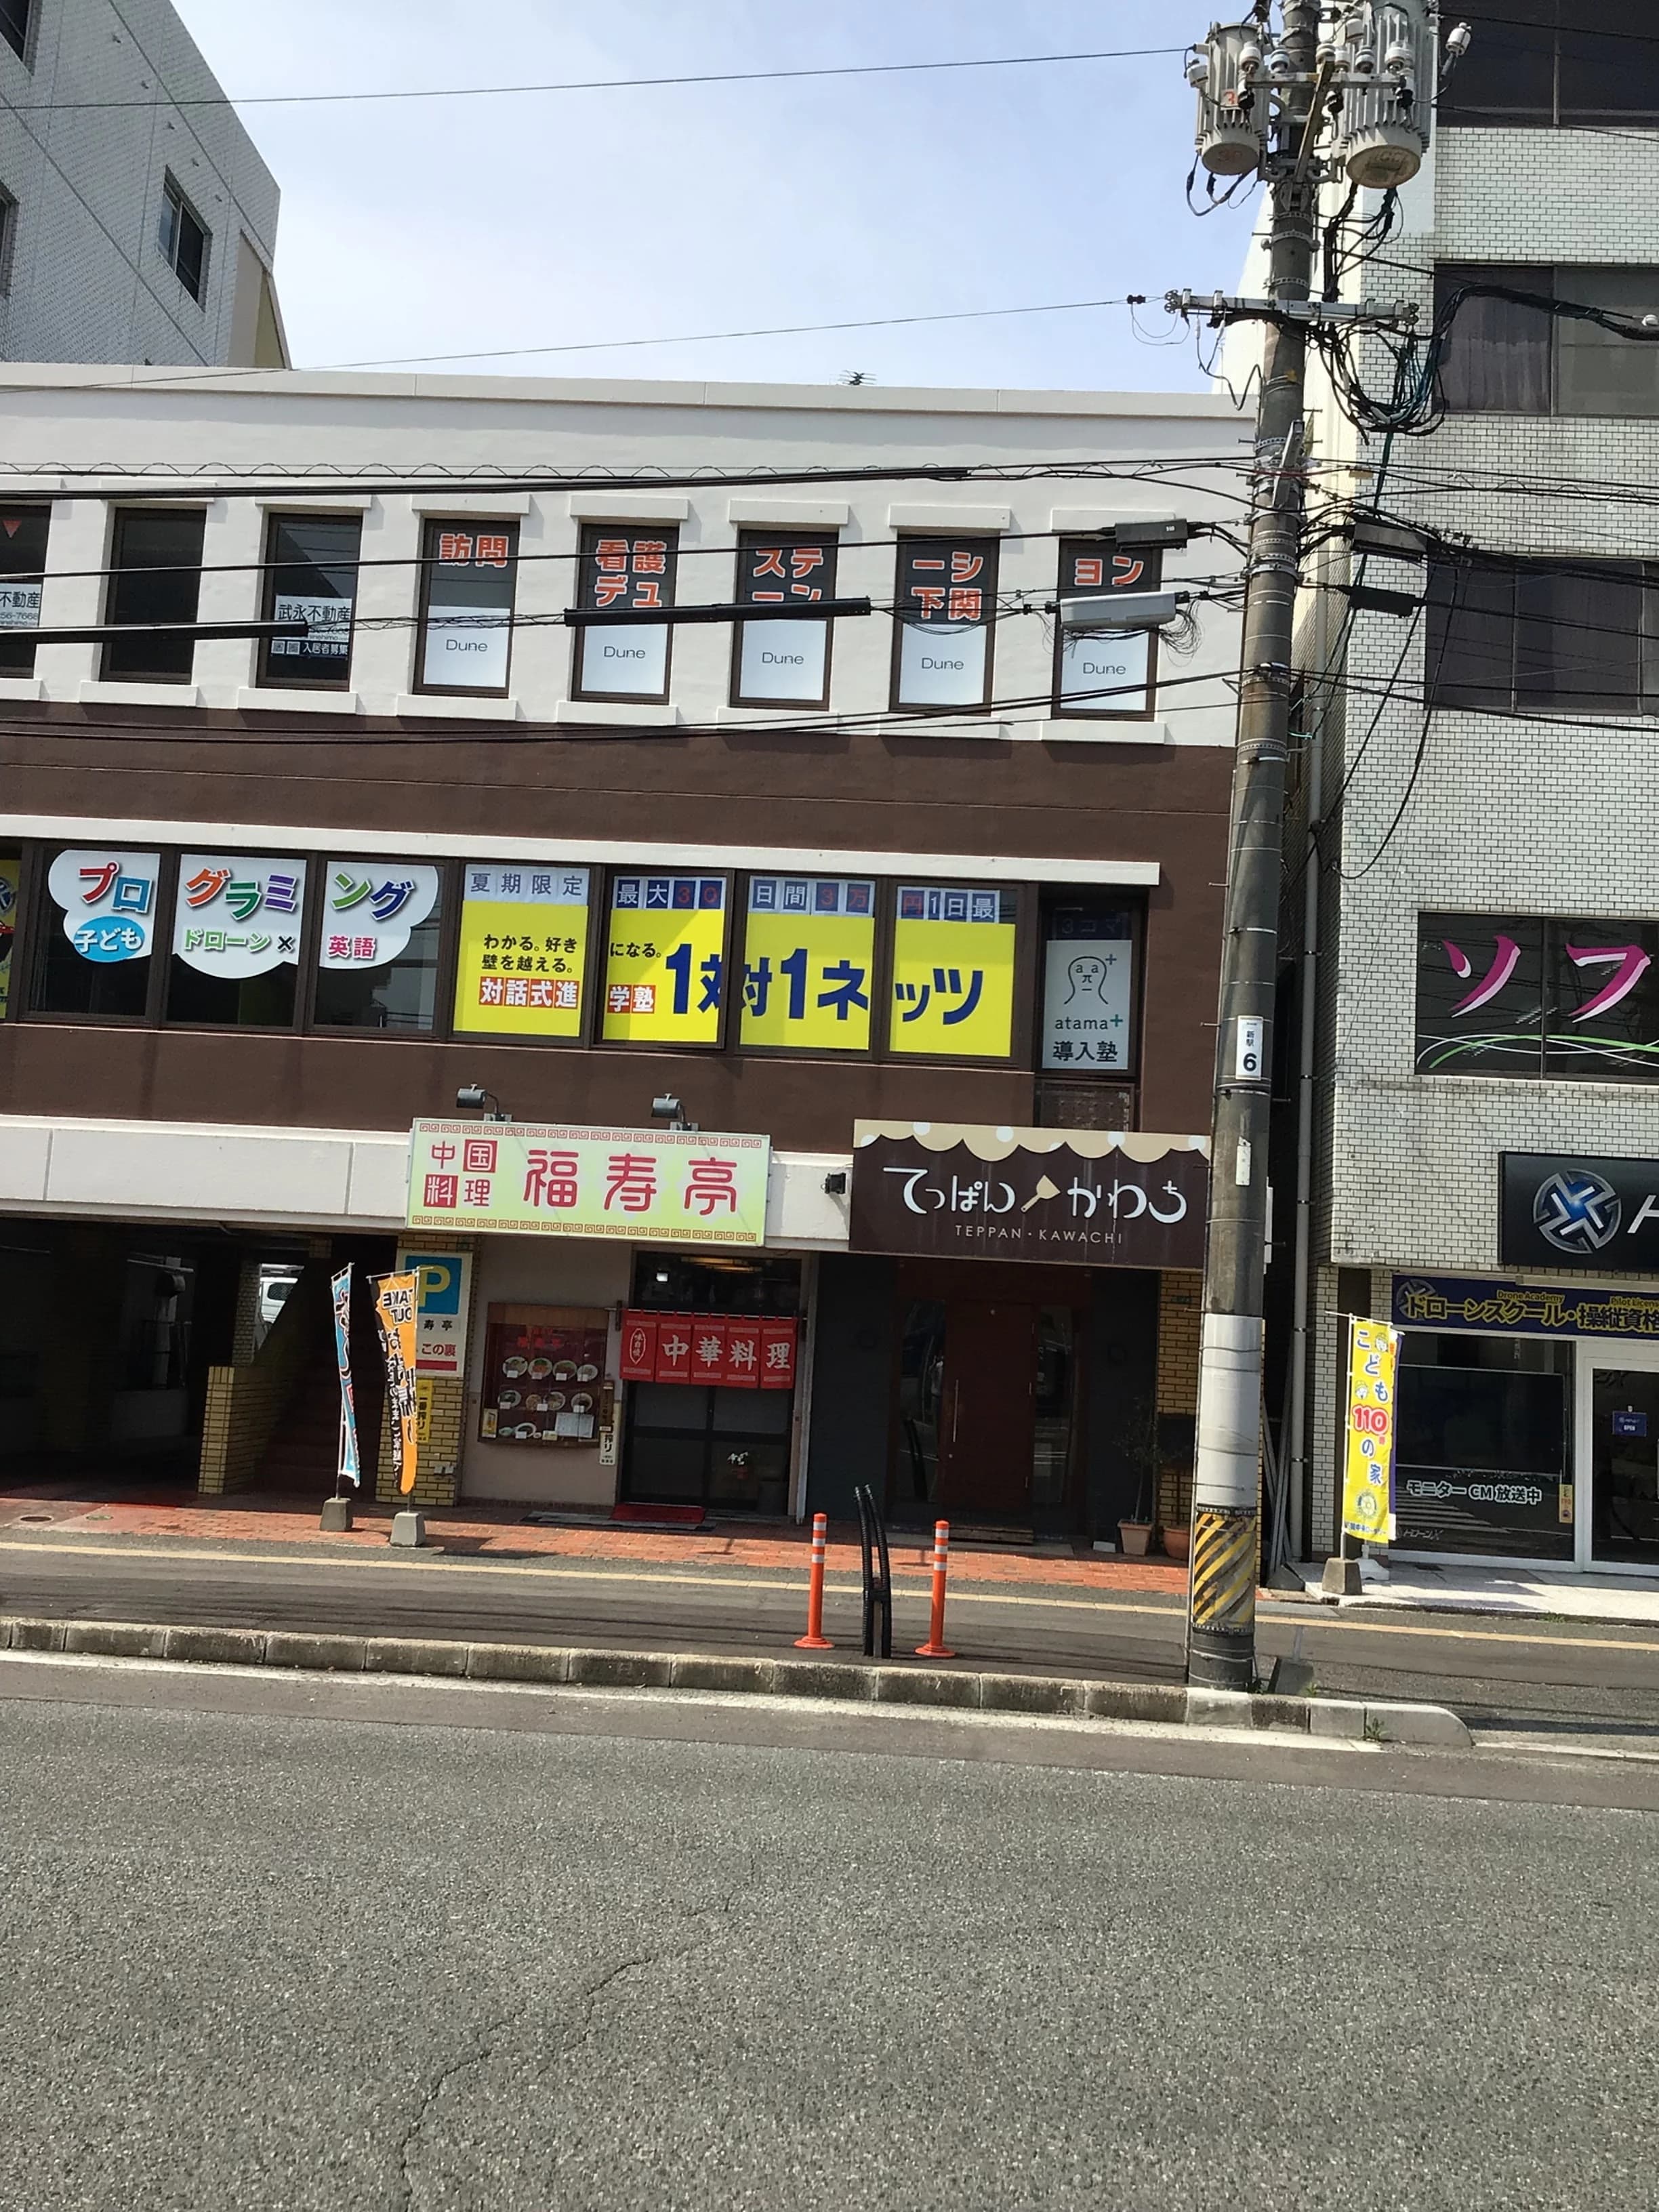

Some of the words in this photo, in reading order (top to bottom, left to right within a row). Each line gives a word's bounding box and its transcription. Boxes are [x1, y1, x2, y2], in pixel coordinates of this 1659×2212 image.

[438, 533, 508, 568] 訪問
[596, 540, 667, 574] 看護
[754, 548, 823, 577] ステ
[0, 592, 41, 608] 不動産
[912, 585, 982, 621] 下関
[279, 604, 350, 621] 武永不動産
[446, 639, 487, 653] Dune
[604, 646, 646, 659] Dune
[762, 652, 804, 665] Dune
[921, 657, 964, 670] Dune
[1083, 663, 1126, 675] Dune
[79, 861, 152, 914] プロ
[185, 867, 298, 920] グラミ
[332, 872, 414, 920] ング
[470, 872, 583, 897] 夏期限定
[617, 884, 719, 905] 最大30
[756, 885, 868, 907] 日間3万
[74, 928, 144, 953] 子ども
[329, 936, 375, 960] 英語
[483, 934, 577, 953] わかる。好き
[610, 943, 662, 958] になる。
[482, 954, 573, 973] 壁を越える。
[480, 979, 579, 1008] 対話式進
[609, 985, 655, 1013] 学塾
[1052, 1041, 1118, 1062] 導入塾
[1243, 1052, 1257, 1071] 6
[430, 1140, 495, 1171] 中国
[427, 1177, 491, 1207] 料理
[523, 1149, 738, 1215] 福寿亭
[882, 1167, 1015, 1214] てっぱん
[956, 1225, 1021, 1239] TEPPAN
[1038, 1229, 1122, 1244] KAWACHI
[417, 1265, 450, 1307] P
[1525, 1292, 1565, 1303] Academy
[662, 1334, 792, 1372] 中華料理
